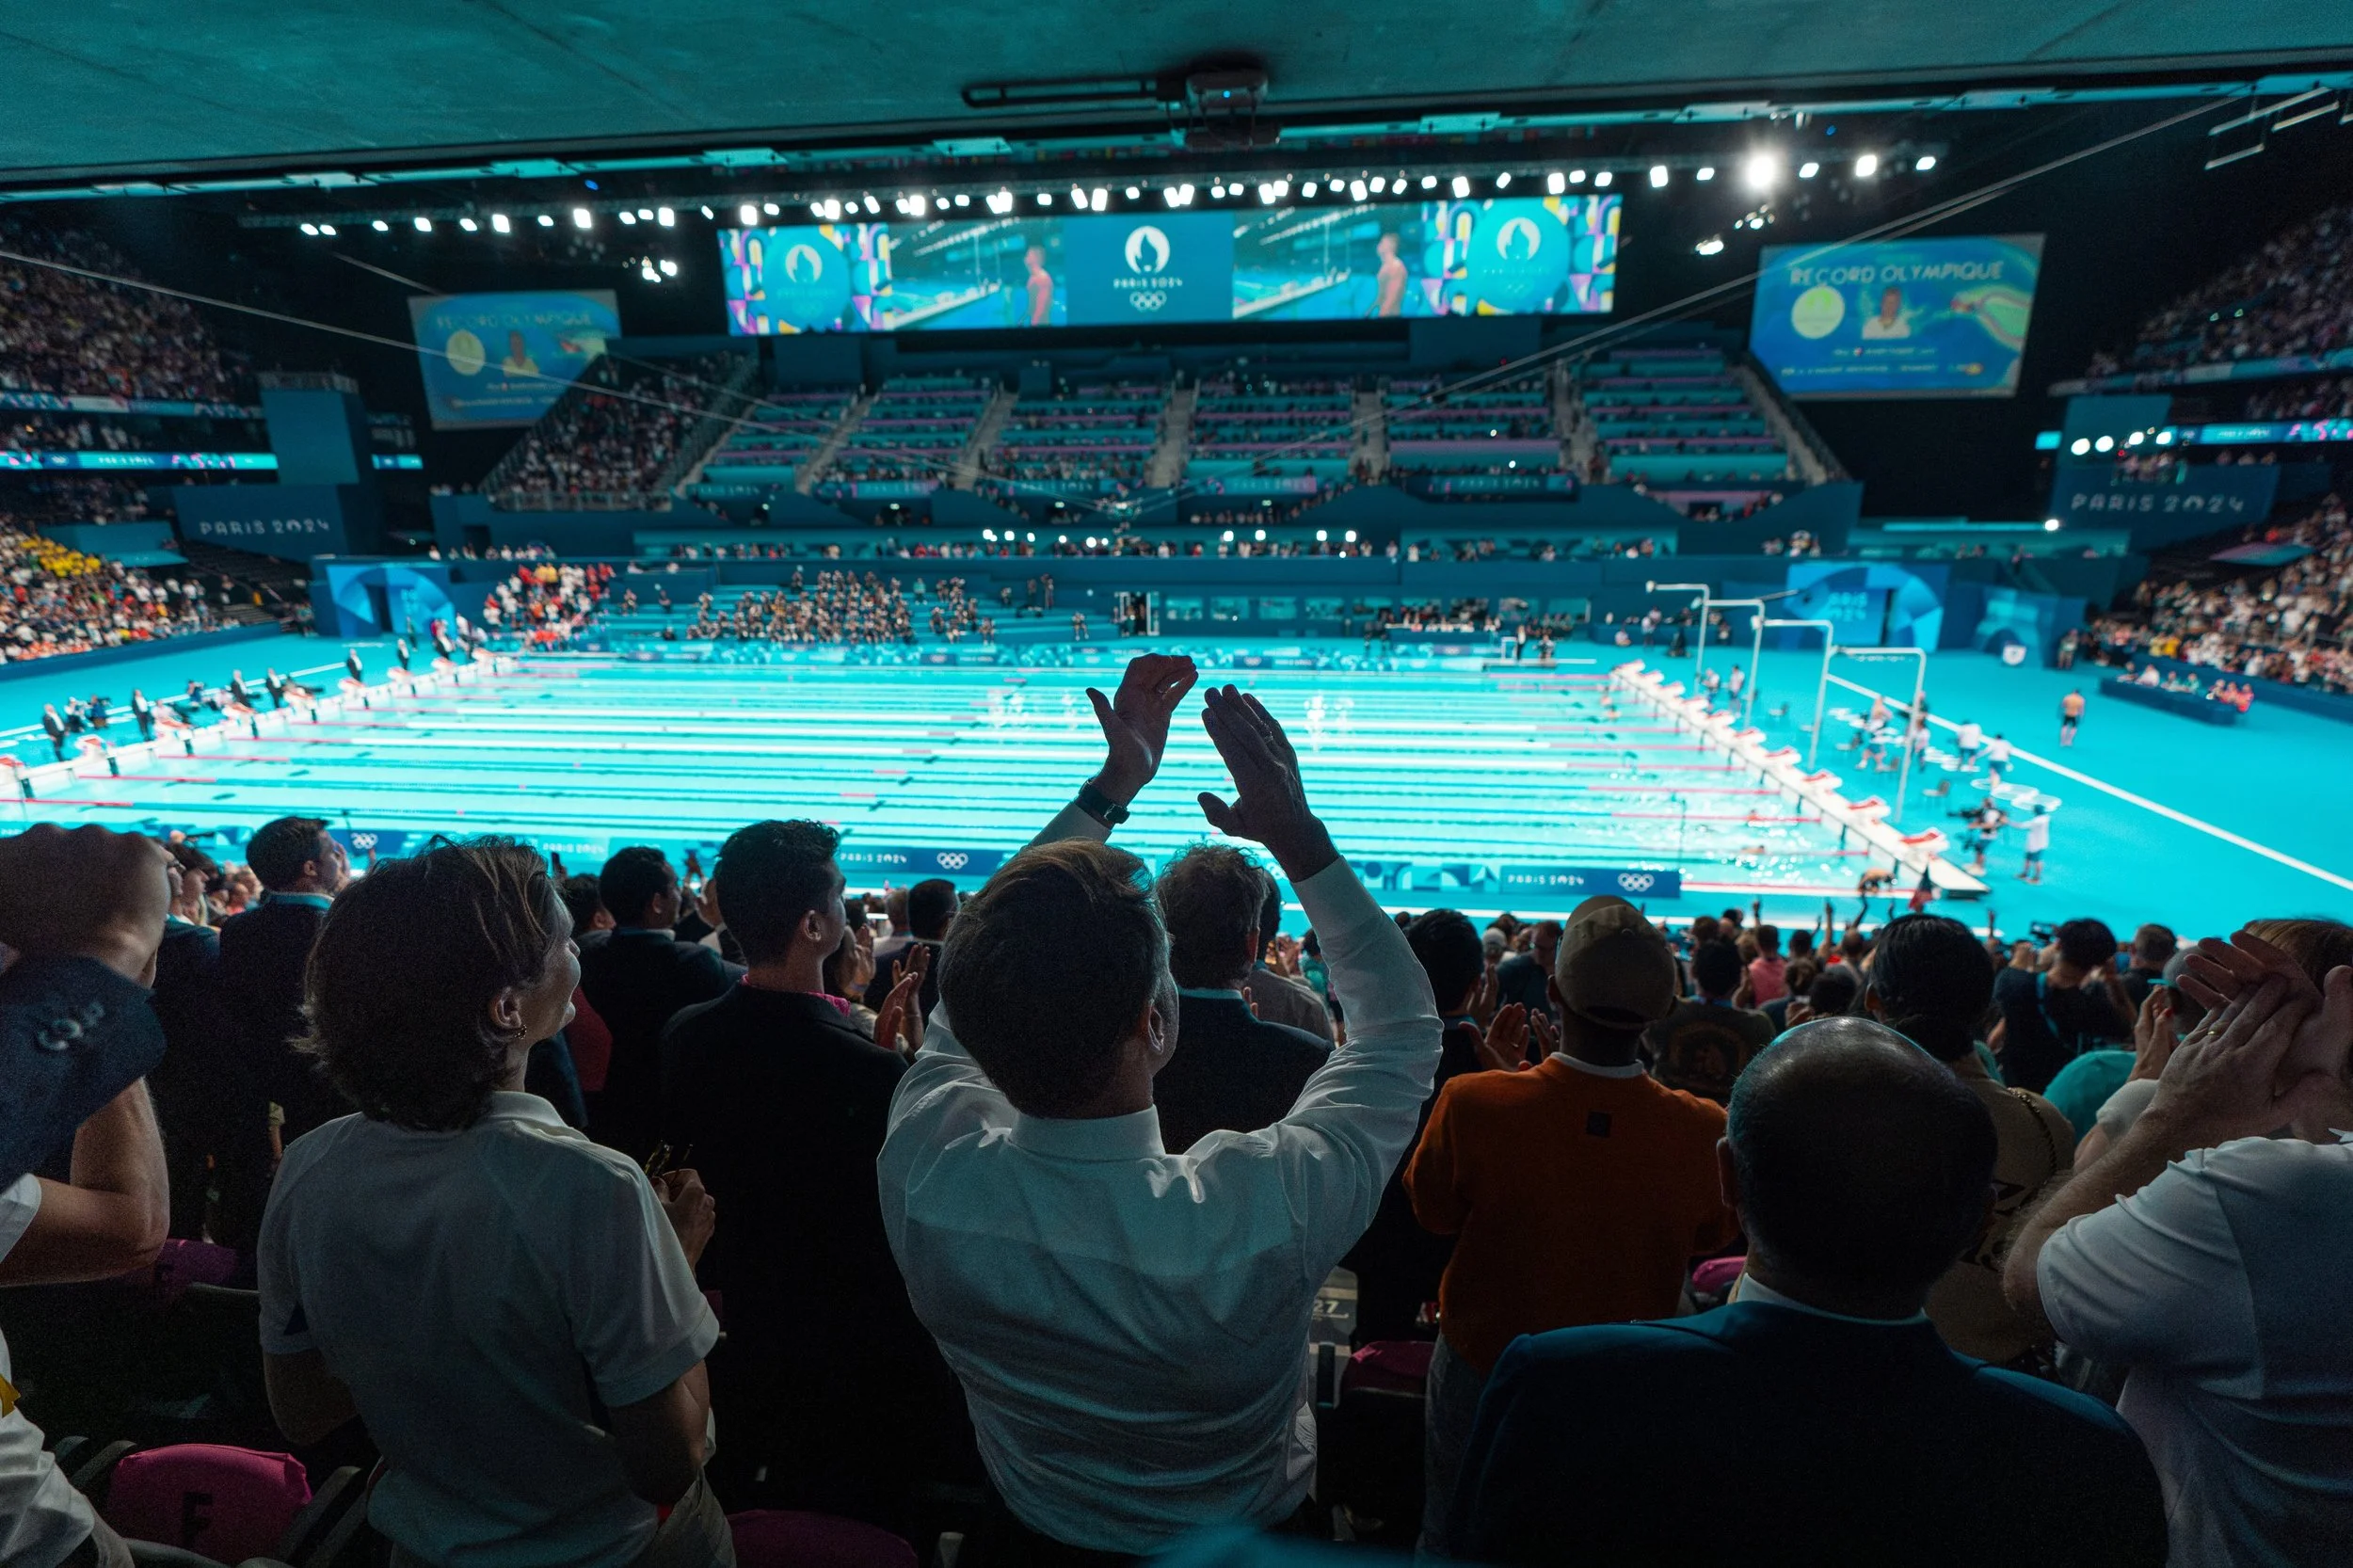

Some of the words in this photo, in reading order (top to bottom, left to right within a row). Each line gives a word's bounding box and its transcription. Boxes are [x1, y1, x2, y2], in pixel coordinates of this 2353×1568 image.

[1790, 266, 1875, 285] RECORD
[1881, 260, 2005, 282] OLYMPIQUE
[2071, 492, 2154, 512] PARIS
[2164, 493, 2245, 513] 2024
[199, 520, 265, 536] PARIS
[271, 518, 329, 534] 2024
[1508, 874, 1545, 885] PARIS
[1549, 874, 1585, 886] 2024
